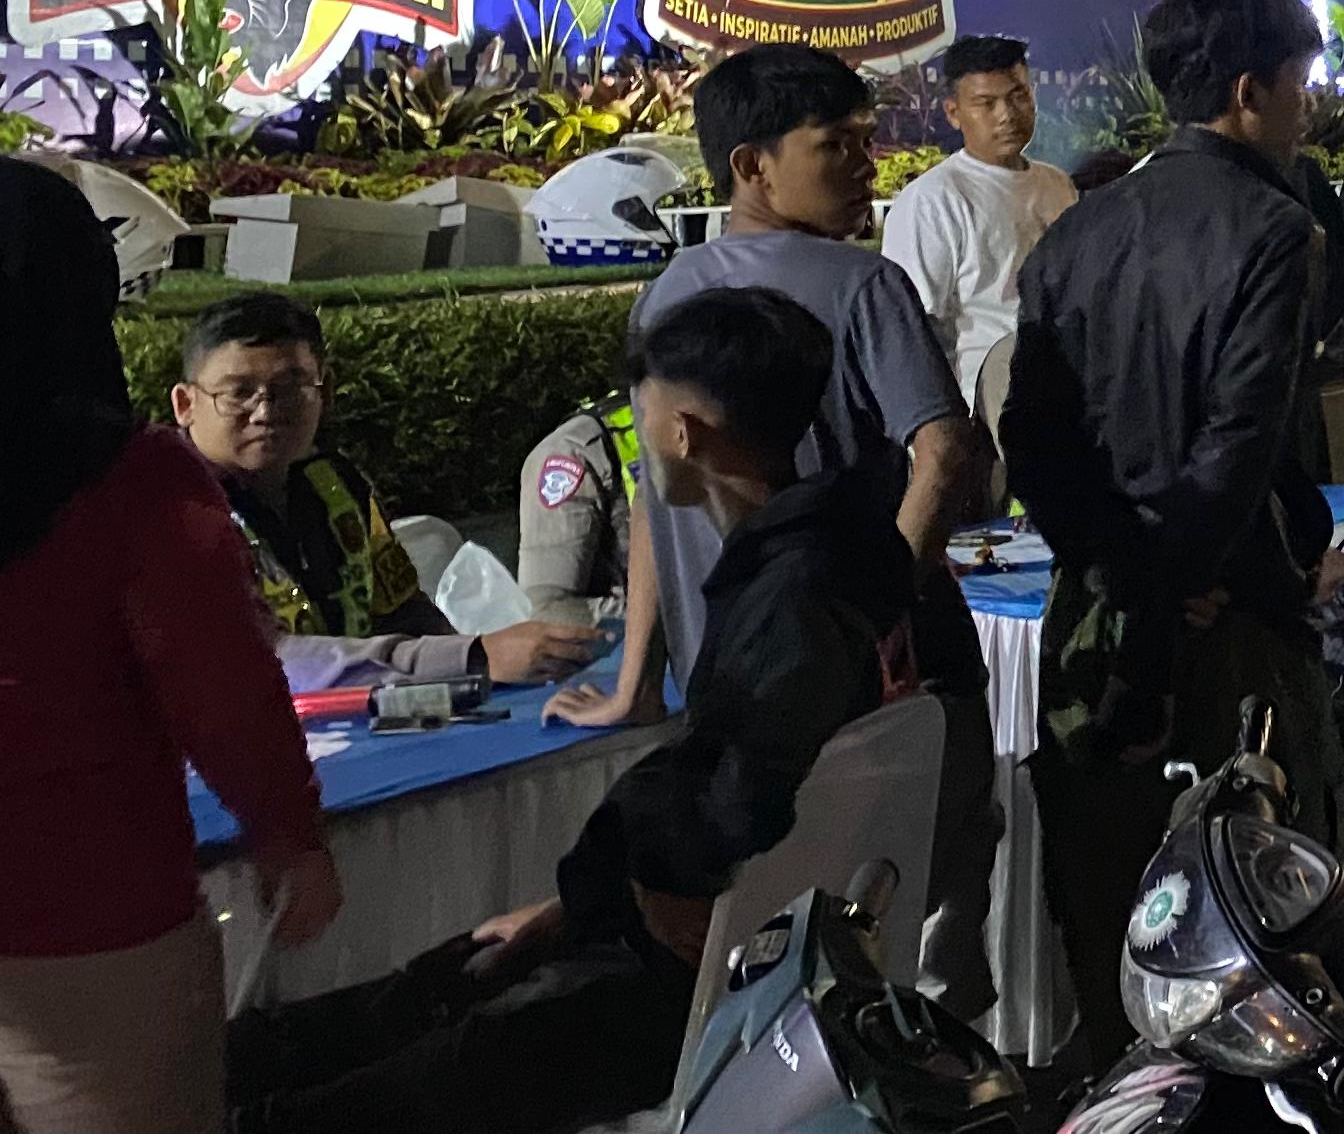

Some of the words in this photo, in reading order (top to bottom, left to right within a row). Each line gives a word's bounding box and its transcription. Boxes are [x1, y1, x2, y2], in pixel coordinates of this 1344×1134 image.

[719, 11, 801, 45] INSPIRATIF
[808, 25, 868, 48] AMANAH
[876, 3, 940, 43] PRODUKTIF
